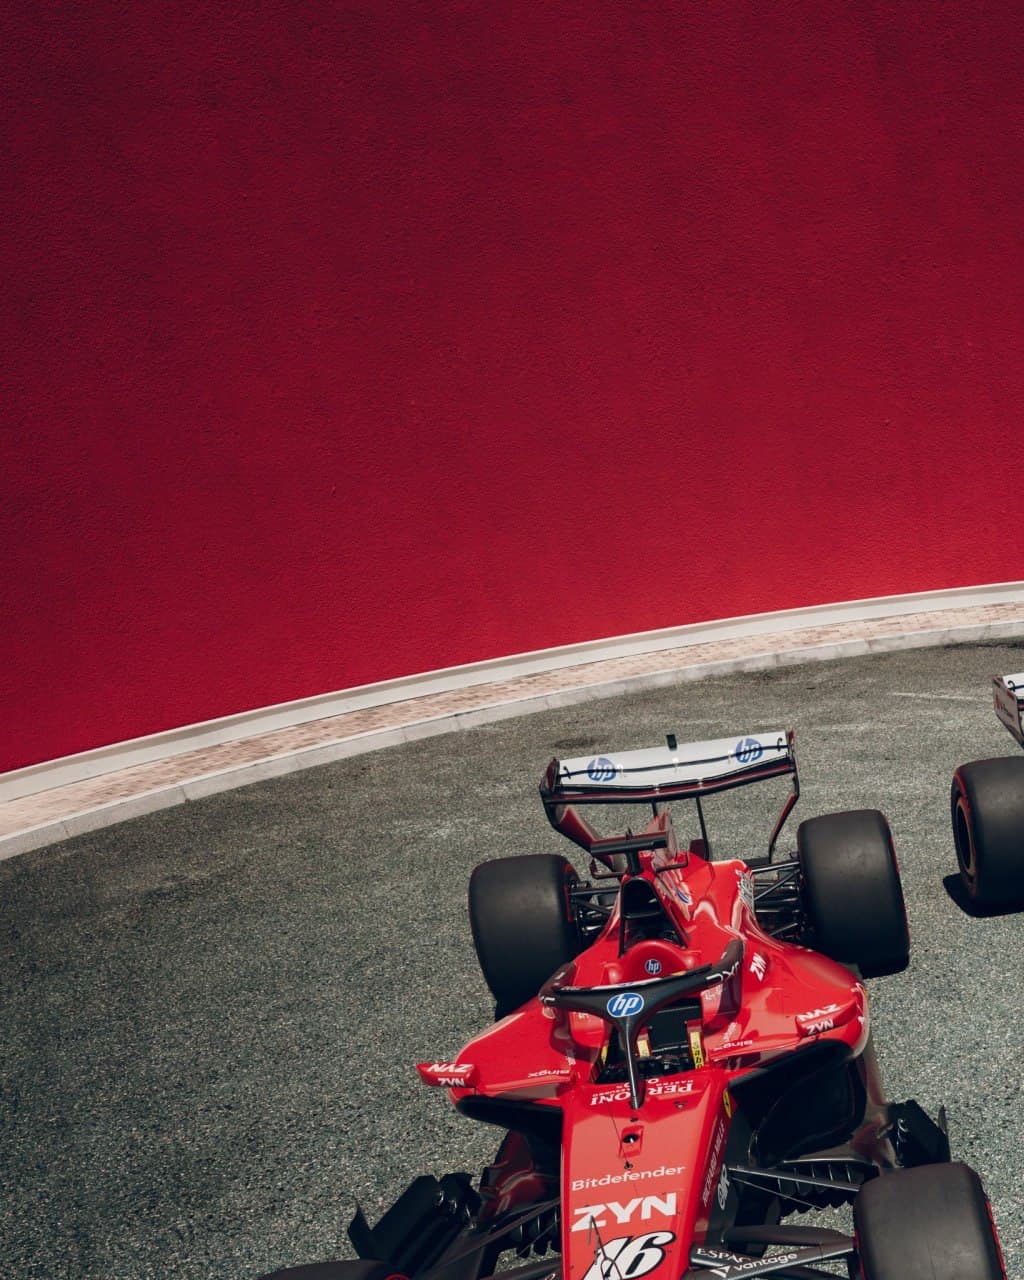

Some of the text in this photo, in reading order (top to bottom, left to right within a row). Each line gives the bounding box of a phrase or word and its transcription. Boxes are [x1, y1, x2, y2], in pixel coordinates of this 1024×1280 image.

[737, 739, 761, 763] hp
[590, 758, 614, 781] hp
[647, 959, 661, 974] hp
[612, 994, 642, 1016] hp
[807, 1019, 833, 1034] ZYN
[572, 1166, 686, 1191] Bitdefender
[571, 1193, 676, 1232] ZYN
[733, 1252, 798, 1271] vantage
